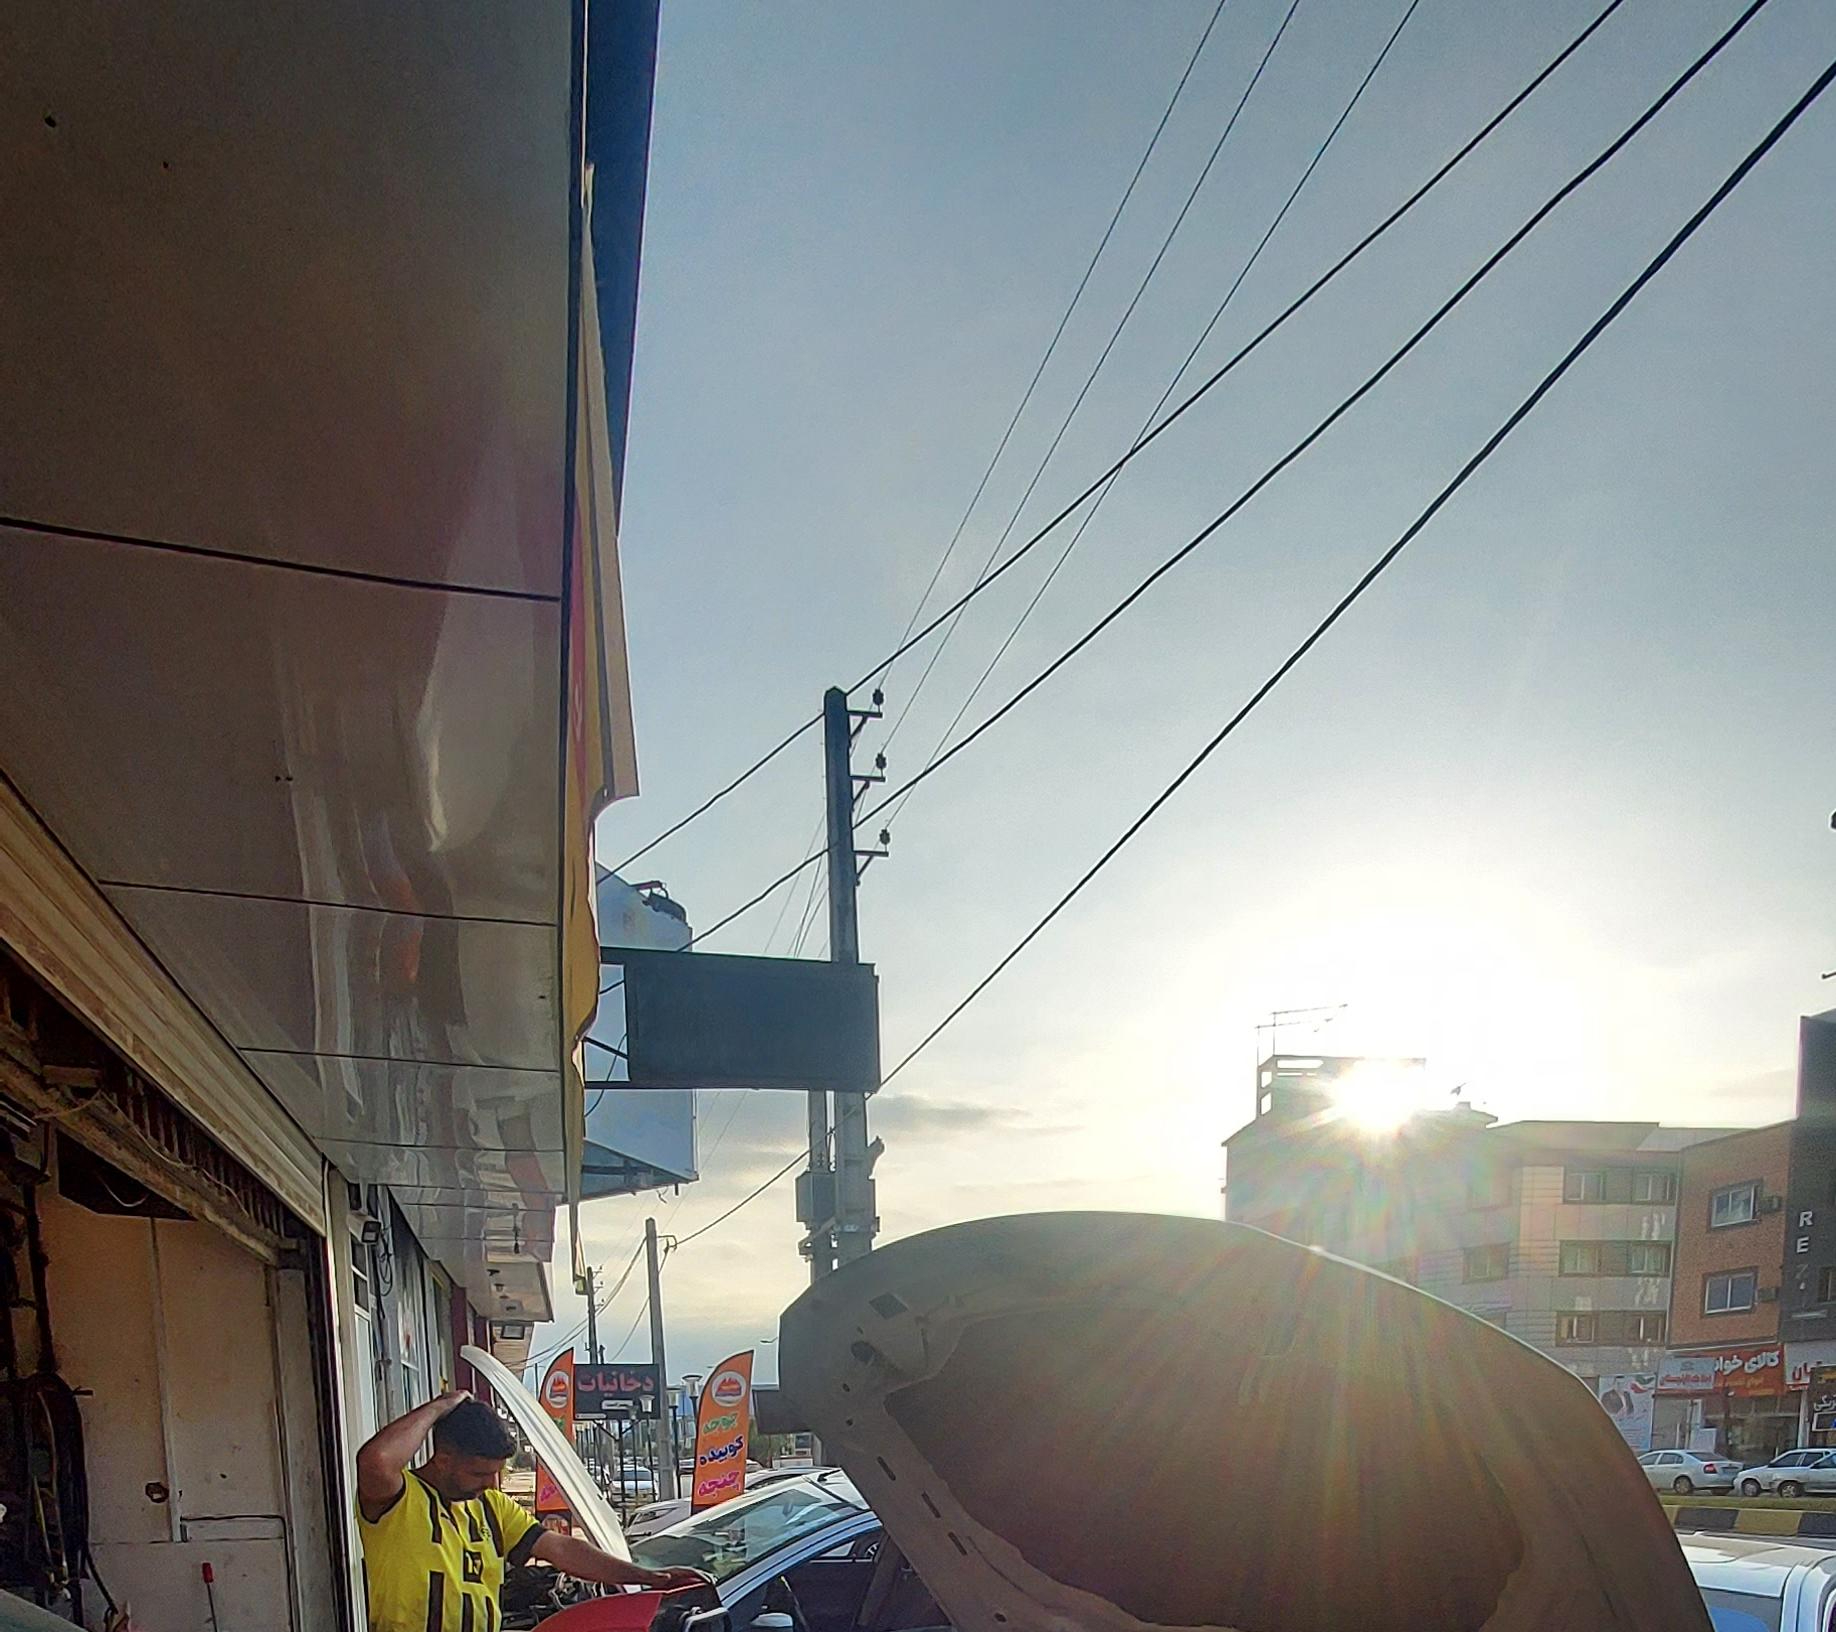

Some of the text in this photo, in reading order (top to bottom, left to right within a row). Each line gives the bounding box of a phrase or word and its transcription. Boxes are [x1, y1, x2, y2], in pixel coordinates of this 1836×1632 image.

[1744, 1350, 1780, 1373] کالای
[577, 1370, 655, 1397] دخانیات
[700, 1436, 745, 1467] کوبیده
[698, 1470, 741, 1497] چنجه
